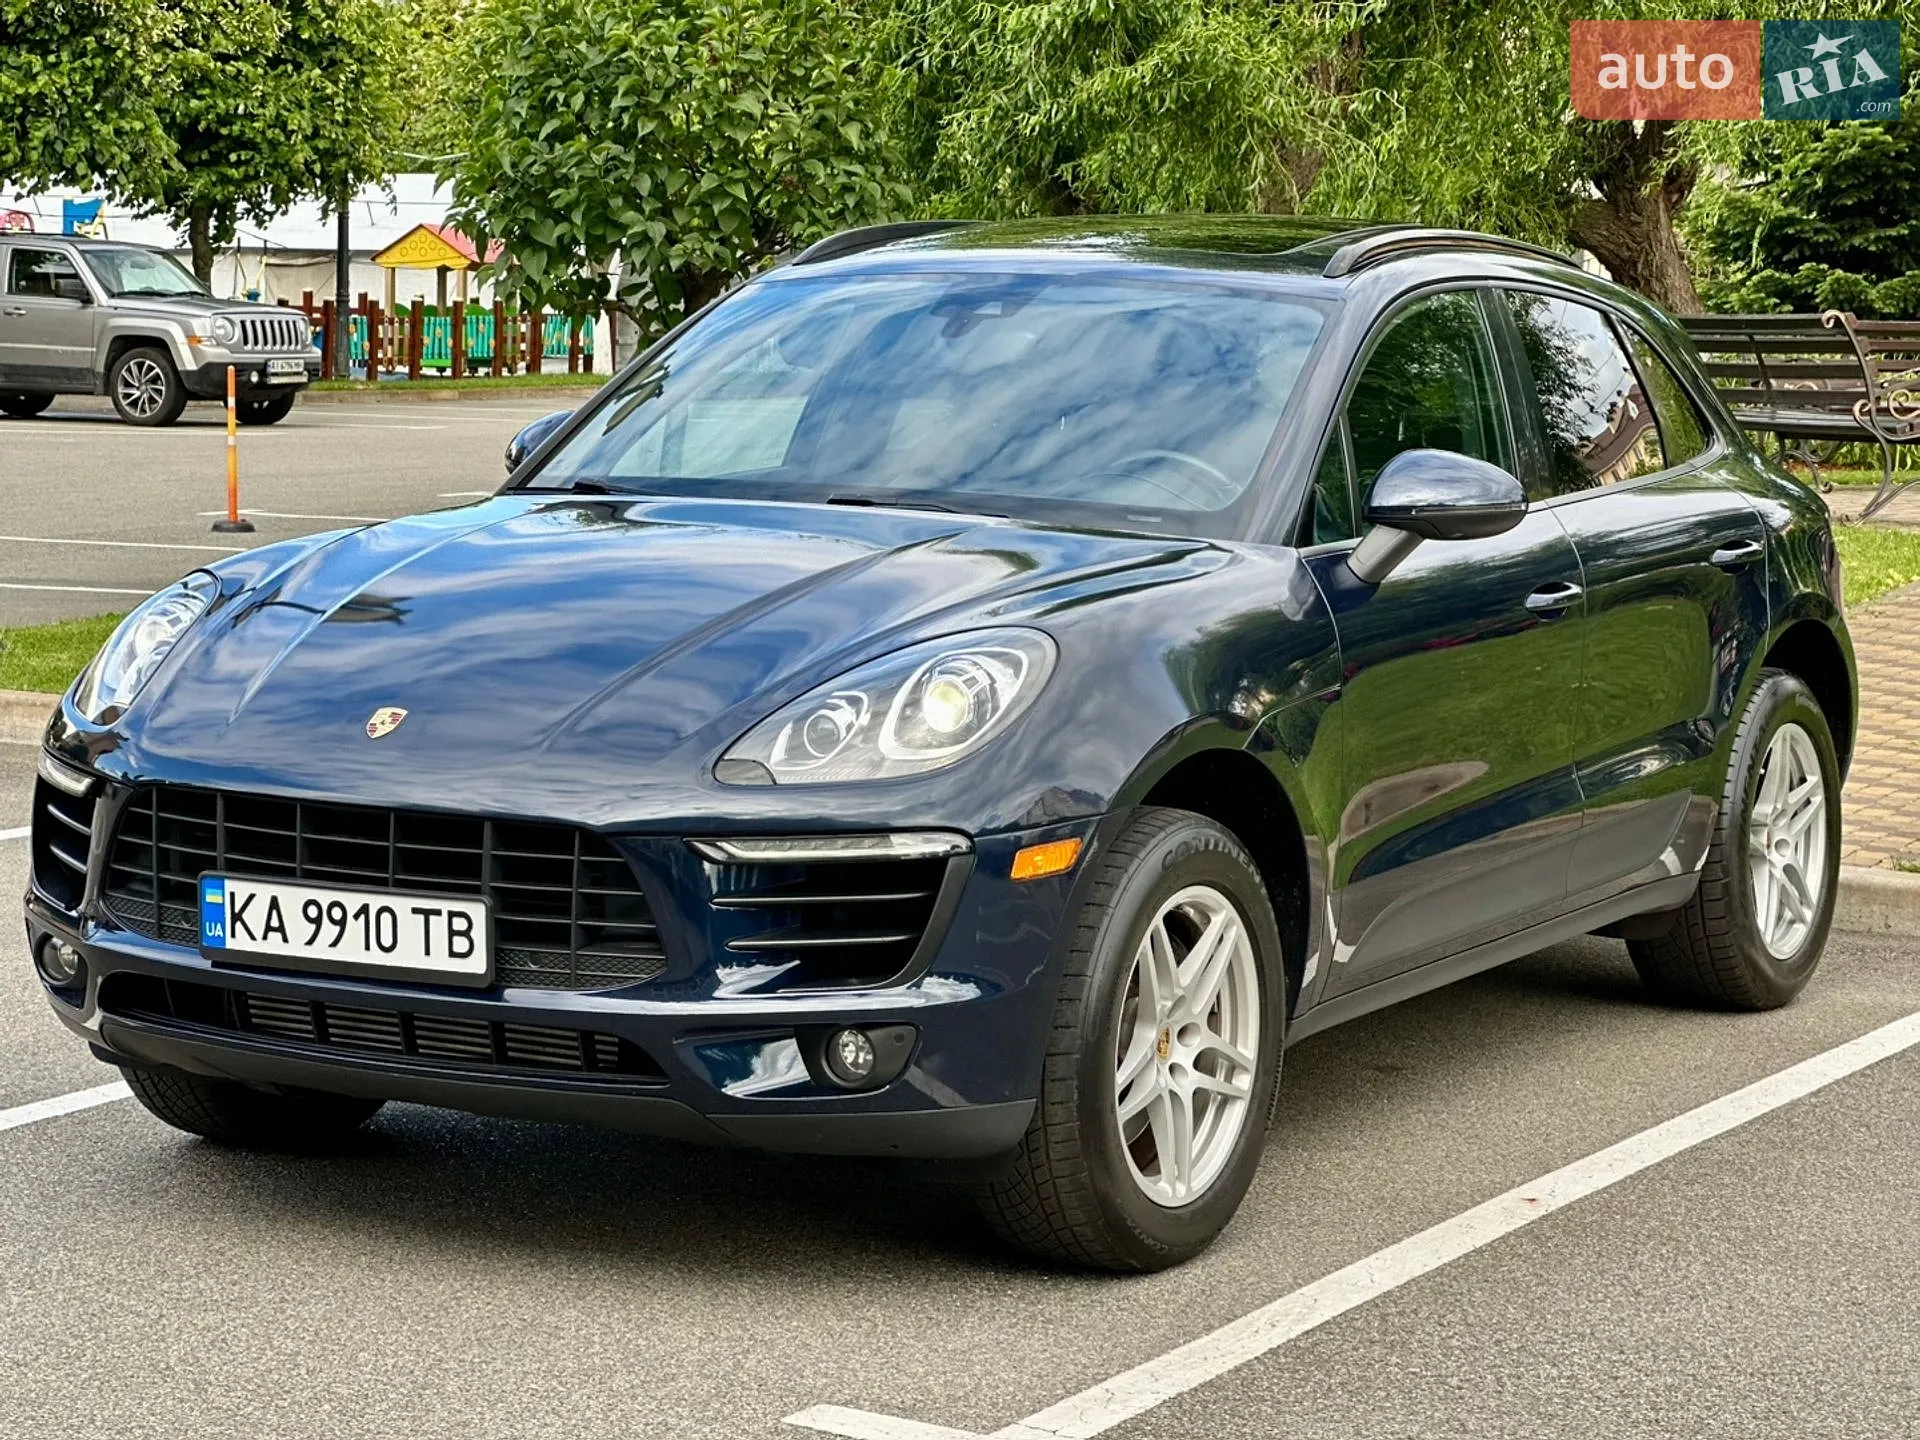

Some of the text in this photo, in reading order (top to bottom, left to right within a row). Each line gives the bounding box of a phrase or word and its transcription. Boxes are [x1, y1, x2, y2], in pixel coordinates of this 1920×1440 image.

[205, 921, 224, 938] UA
[229, 891, 475, 959] KA 9910 TB
